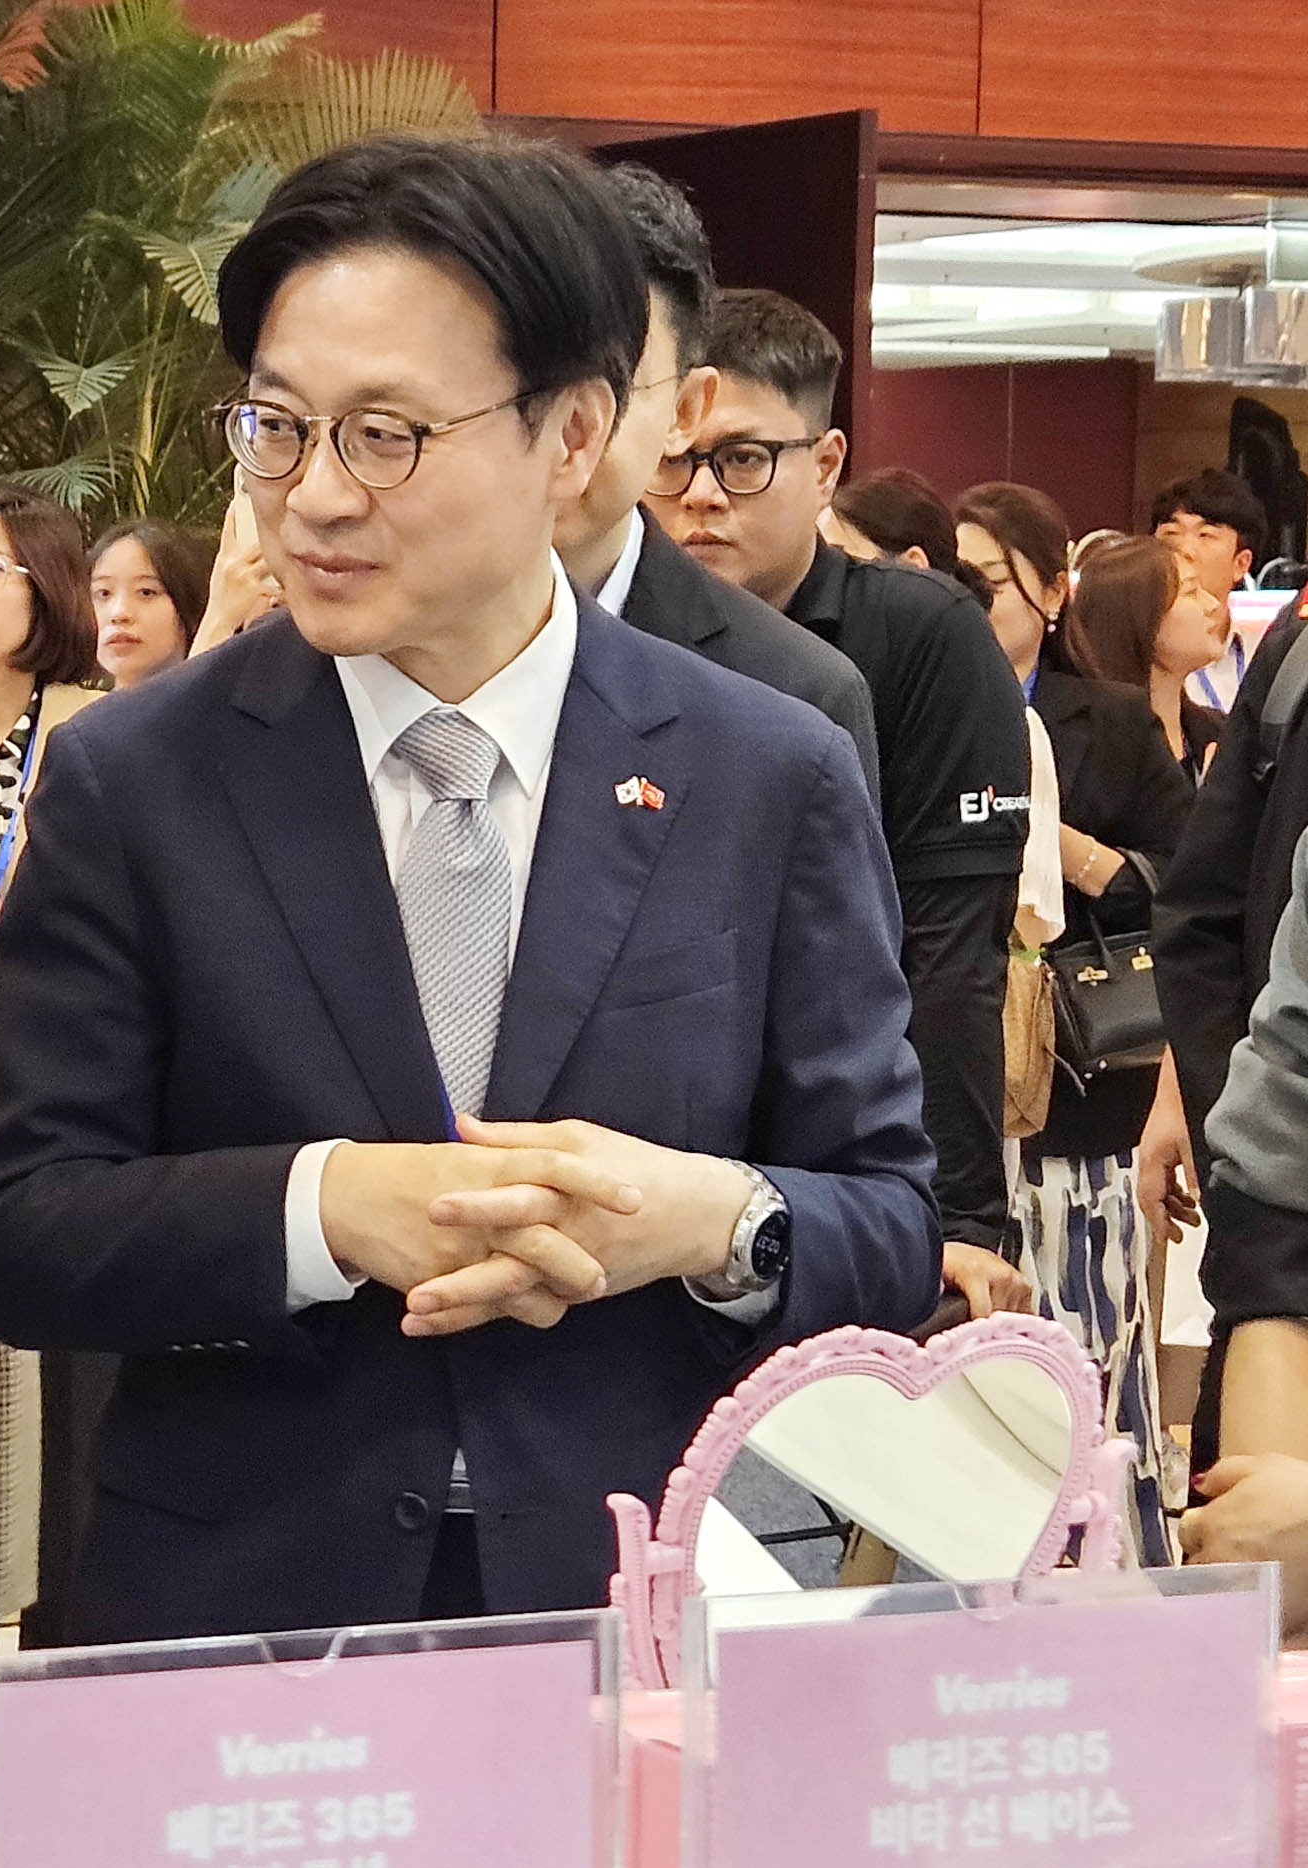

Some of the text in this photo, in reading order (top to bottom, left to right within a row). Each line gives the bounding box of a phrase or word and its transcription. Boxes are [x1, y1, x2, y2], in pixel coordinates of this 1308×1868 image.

[935, 1664, 1069, 1715] Verries
[218, 1724, 369, 1779] Verries
[1020, 1729, 1110, 1778] 365
[315, 1790, 416, 1843] 365
[870, 1798, 949, 1855] 비타
[961, 1794, 1001, 1847] 선
